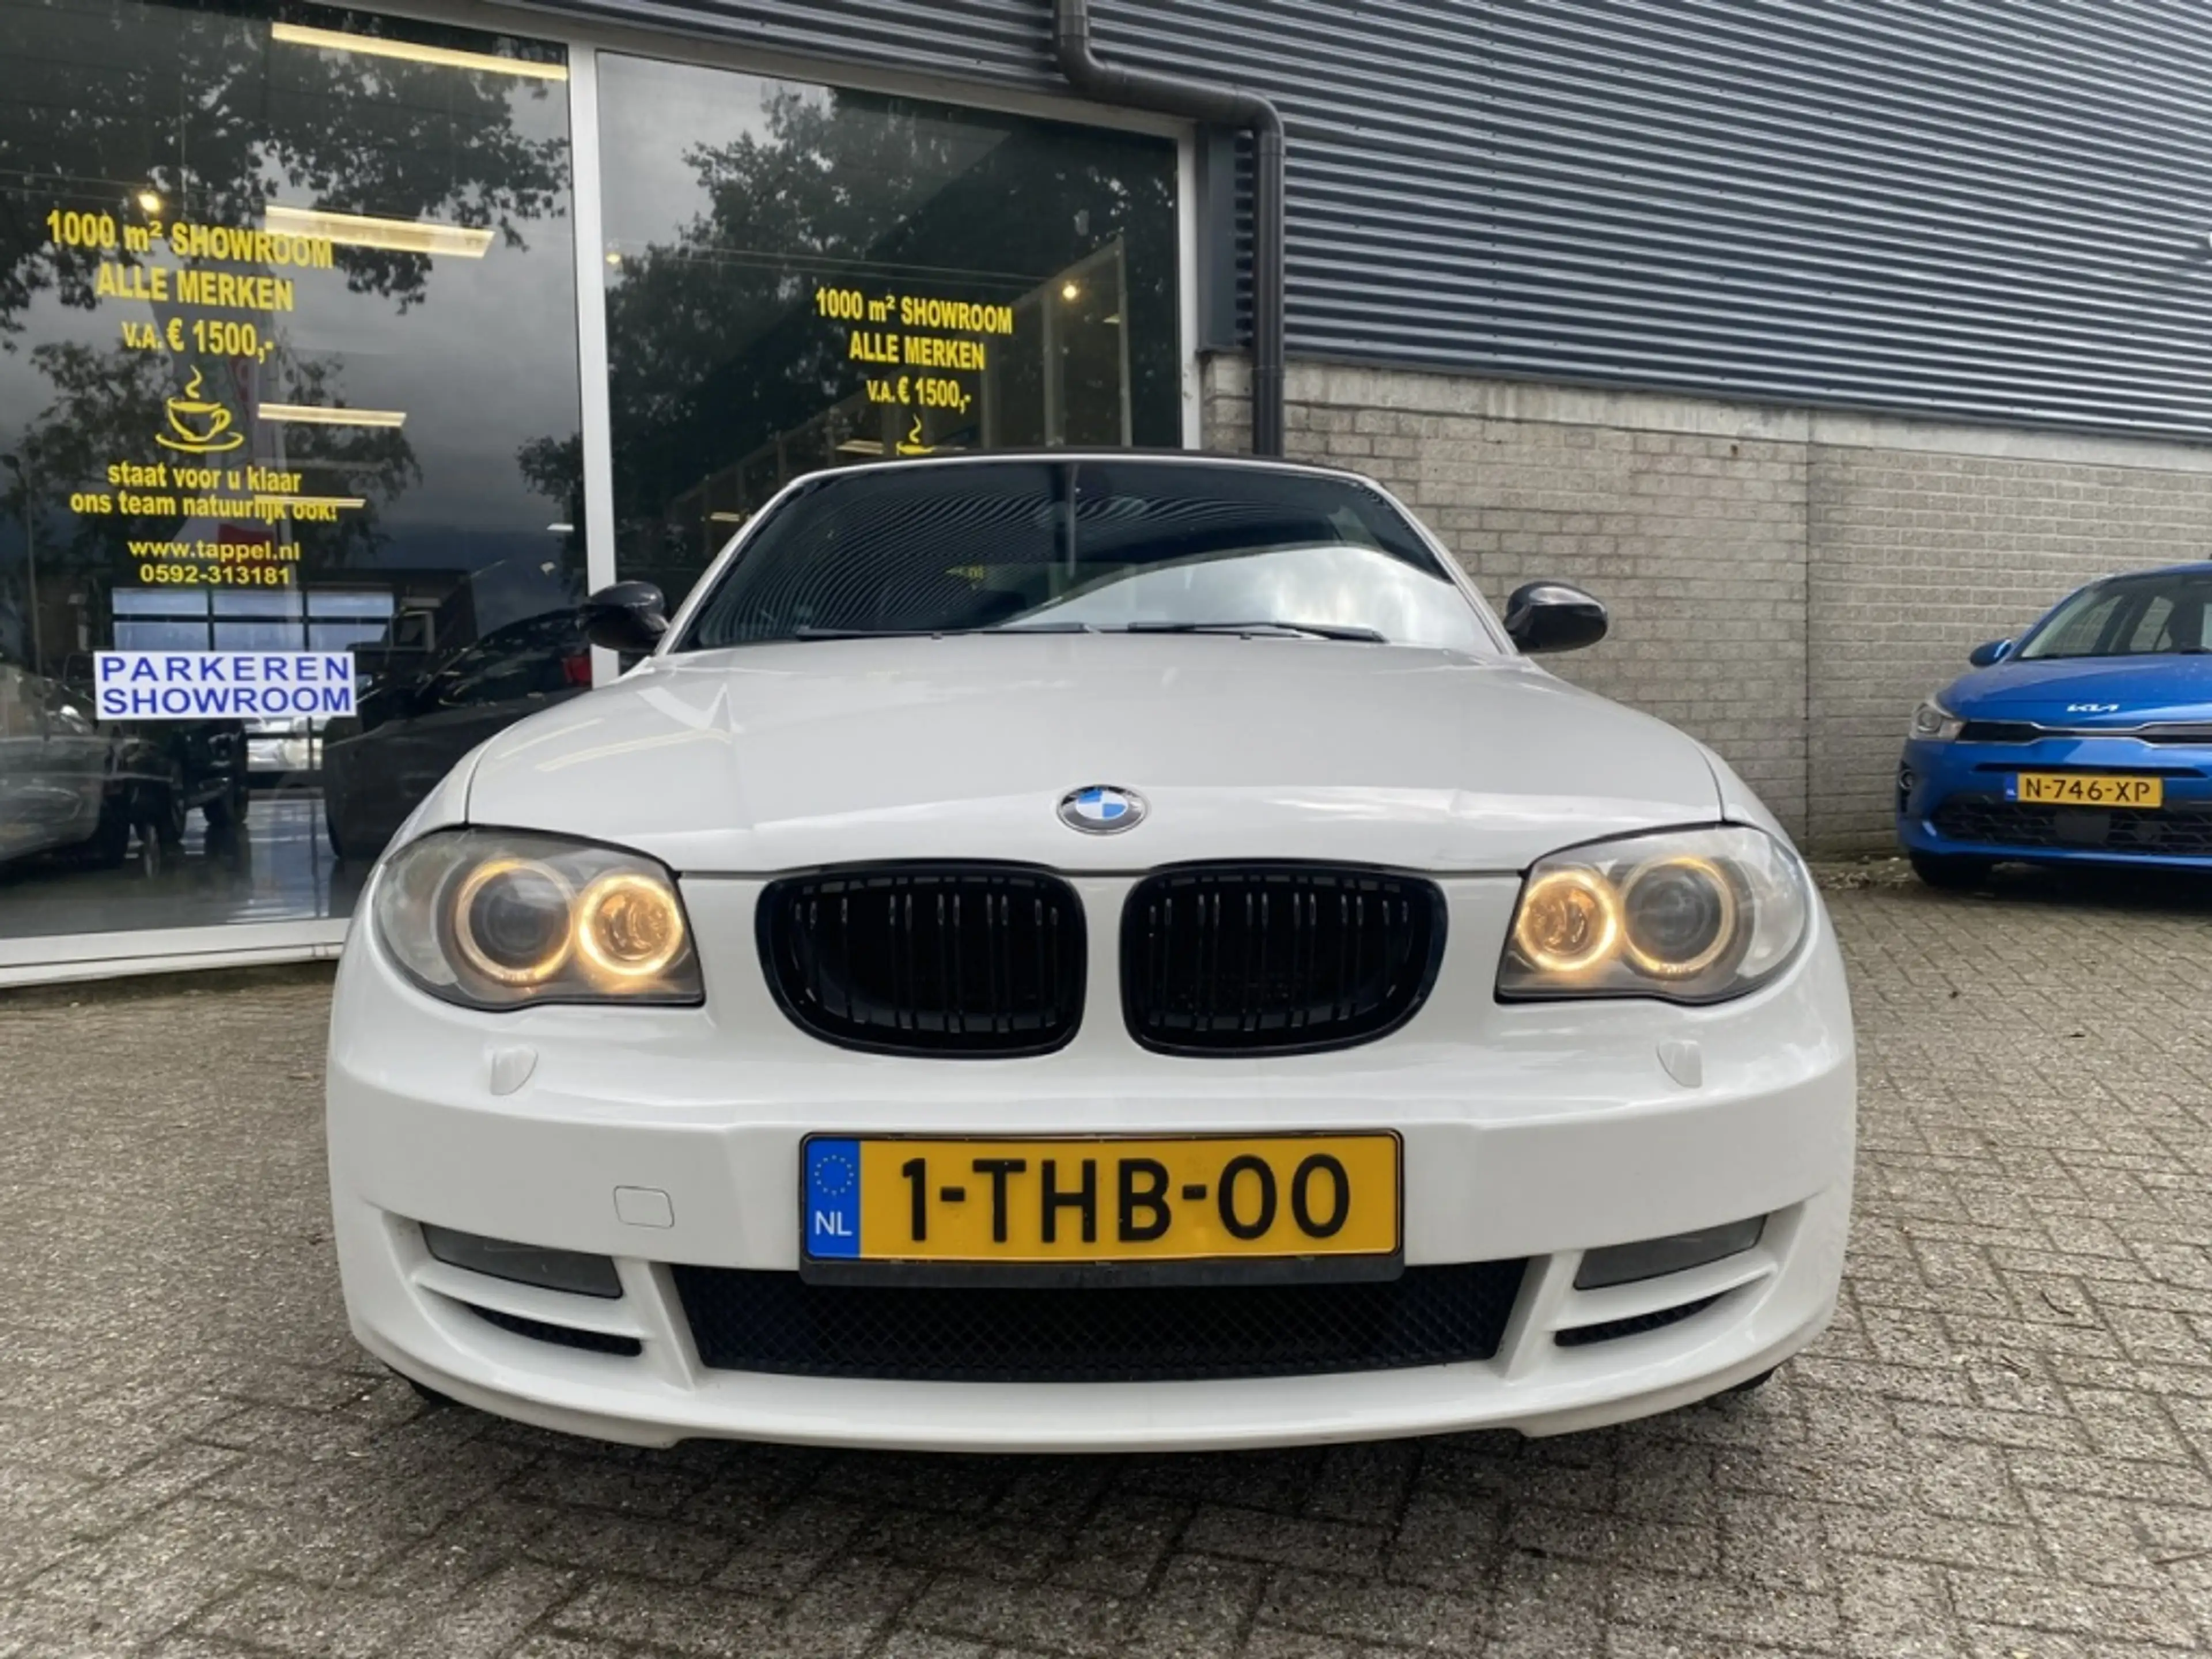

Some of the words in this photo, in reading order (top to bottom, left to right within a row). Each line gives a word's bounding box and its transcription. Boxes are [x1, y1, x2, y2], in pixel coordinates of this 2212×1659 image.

[47, 210, 114, 248] 1000
[172, 222, 333, 268] SHOWROOM
[97, 263, 167, 301] ALLE
[177, 270, 293, 311] MERKEN
[816, 287, 862, 320] 1000
[901, 296, 1012, 334] SHOWROOM
[122, 321, 162, 349] V.A.
[167, 318, 184, 351] €
[192, 320, 273, 363] 1500,-
[850, 331, 899, 363] ALLE
[904, 336, 984, 370] MERKEN
[867, 380, 895, 403] V.A.
[897, 376, 910, 405] €
[915, 378, 971, 414] 1500,-
[108, 461, 166, 487] staat
[173, 469, 220, 490] voor
[228, 472, 240, 490] u
[248, 465, 301, 493] klaar
[70, 492, 111, 513] ons
[118, 491, 175, 516] team
[183, 494, 286, 525] natuurlijk
[293, 499, 338, 521] ook!
[127, 540, 300, 563] www.tappel.nl
[140, 565, 289, 585] 0592-313181
[101, 656, 349, 681] PARKEREN
[103, 688, 350, 714] SHOWROOM
[2026, 778, 2150, 802] N-746-XP
[902, 1153, 1350, 1243] 1-THB-00
[815, 1211, 852, 1236] NL
